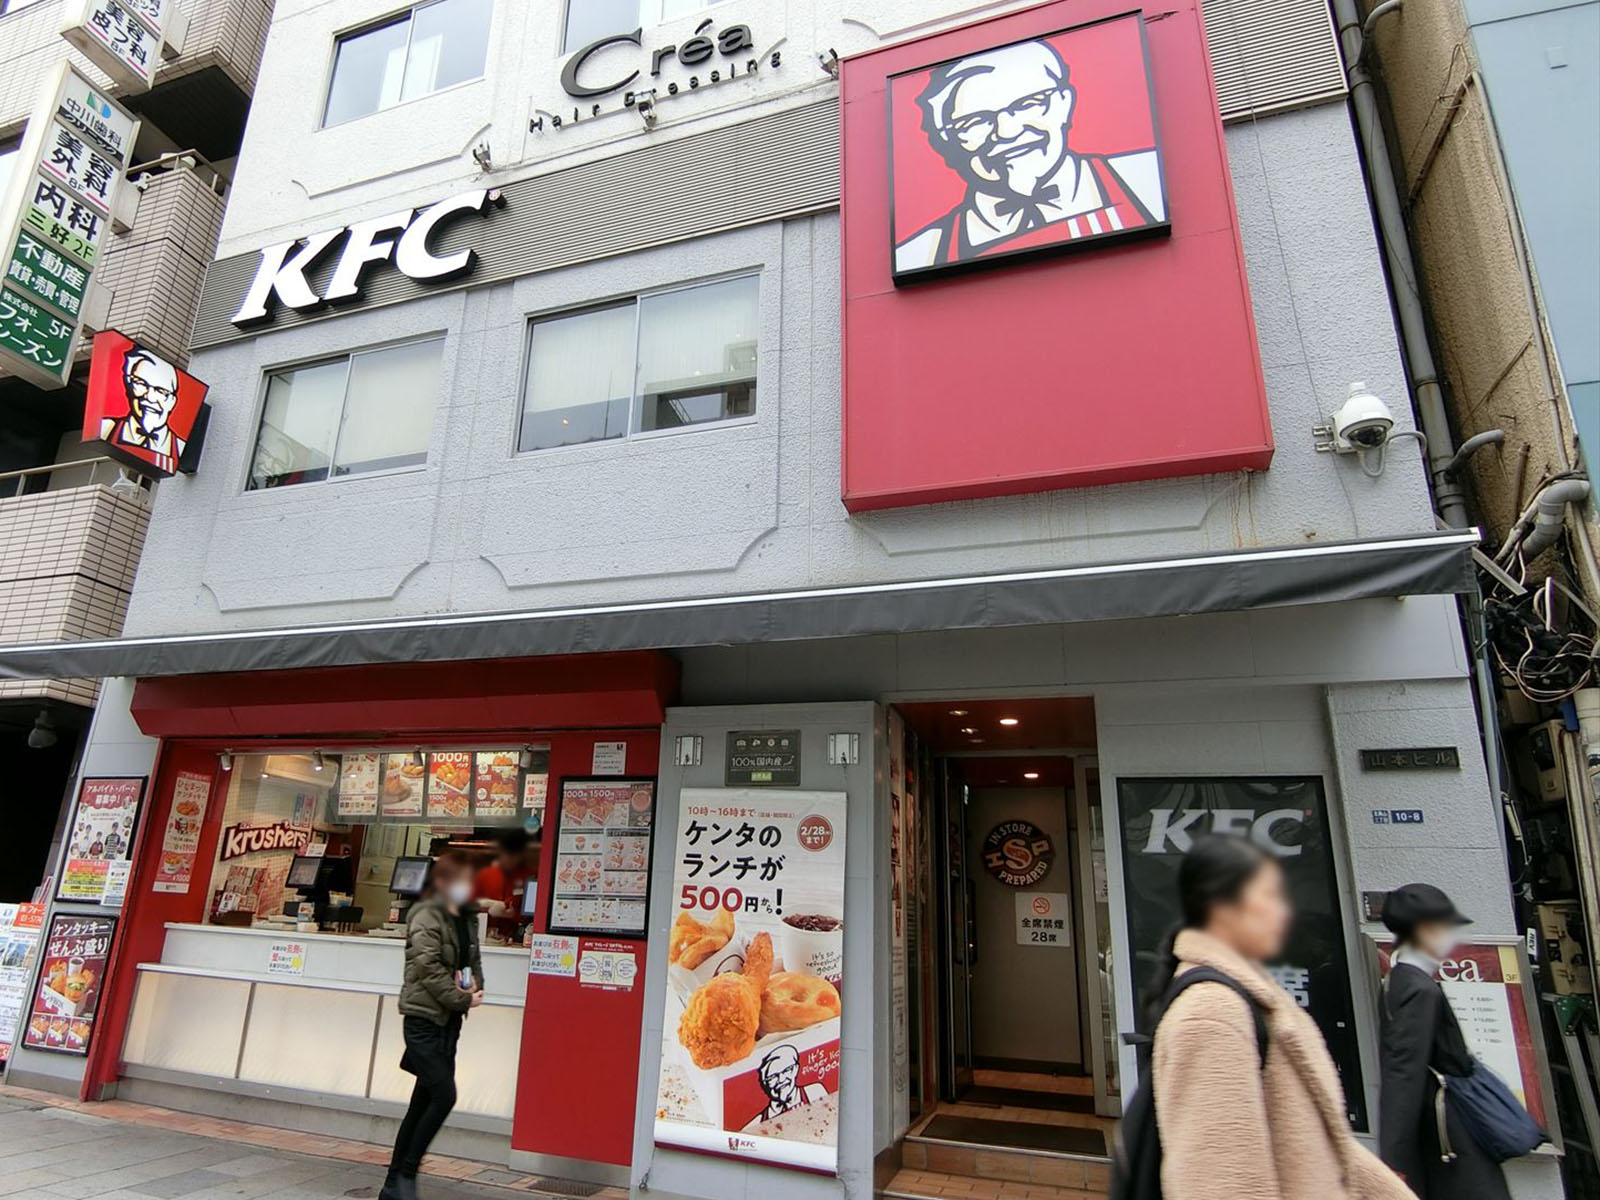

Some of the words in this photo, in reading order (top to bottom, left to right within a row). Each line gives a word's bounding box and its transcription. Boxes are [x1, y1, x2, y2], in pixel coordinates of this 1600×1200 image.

[561, 18, 754, 97] Créa
[66, 97, 122, 149] 中川歯科
[51, 147, 108, 199] 外科
[56, 129, 114, 181] 美容
[26, 207, 71, 245] 三好
[72, 237, 96, 260] 2F
[33, 181, 98, 241] 内科
[18, 233, 86, 293] 不動産
[231, 188, 488, 325] KFC
[48, 318, 72, 340] 5F
[684, 820, 783, 848] ケンタの
[1142, 808, 1305, 857] KFC
[1395, 812, 1421, 822] 10-8
[683, 854, 786, 882] ランチが
[998, 860, 1048, 887] PREPARED
[49, 936, 108, 957] ぜんぶ盛り
[1021, 917, 1064, 930] 全席禁煙
[1031, 931, 1057, 943] 28席
